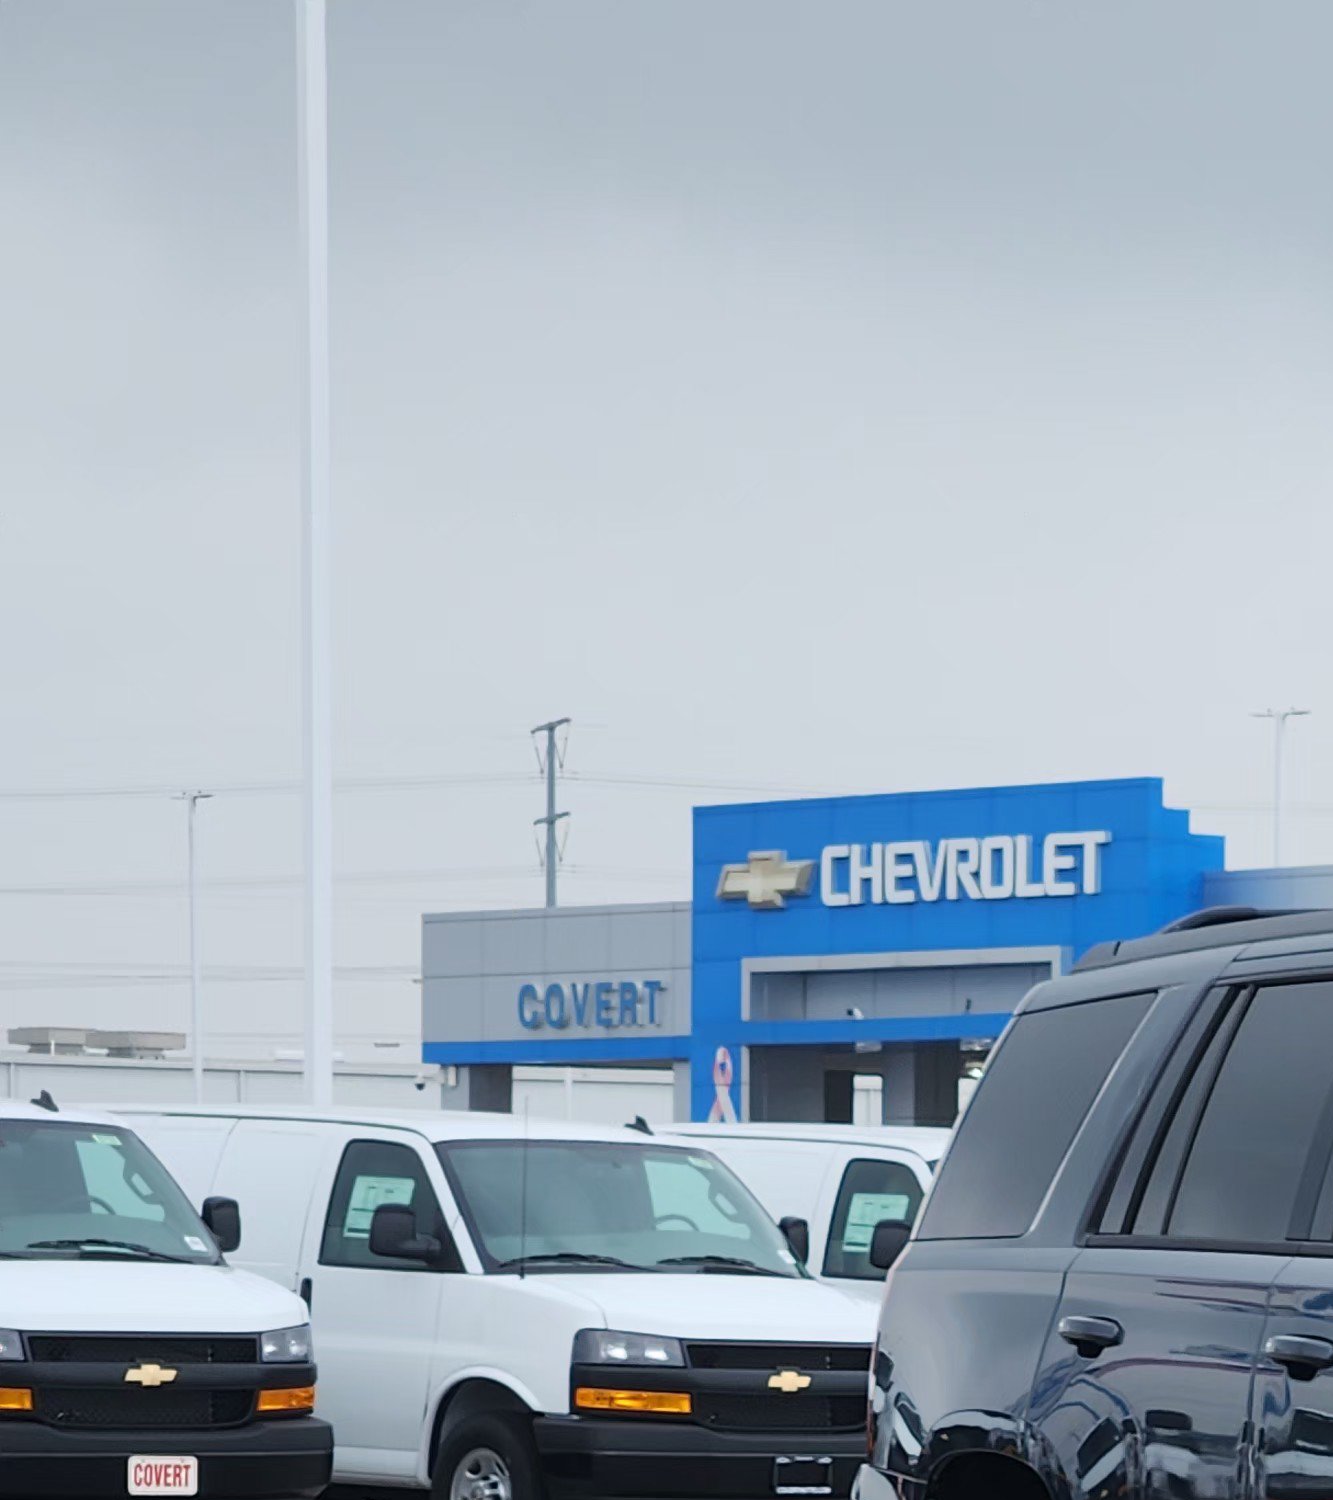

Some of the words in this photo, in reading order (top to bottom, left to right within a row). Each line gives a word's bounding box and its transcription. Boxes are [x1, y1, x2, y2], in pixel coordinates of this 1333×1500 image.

[821, 830, 1111, 907] CHEVROLET
[518, 980, 664, 1029] COVERT
[133, 1463, 191, 1487] COVERT
